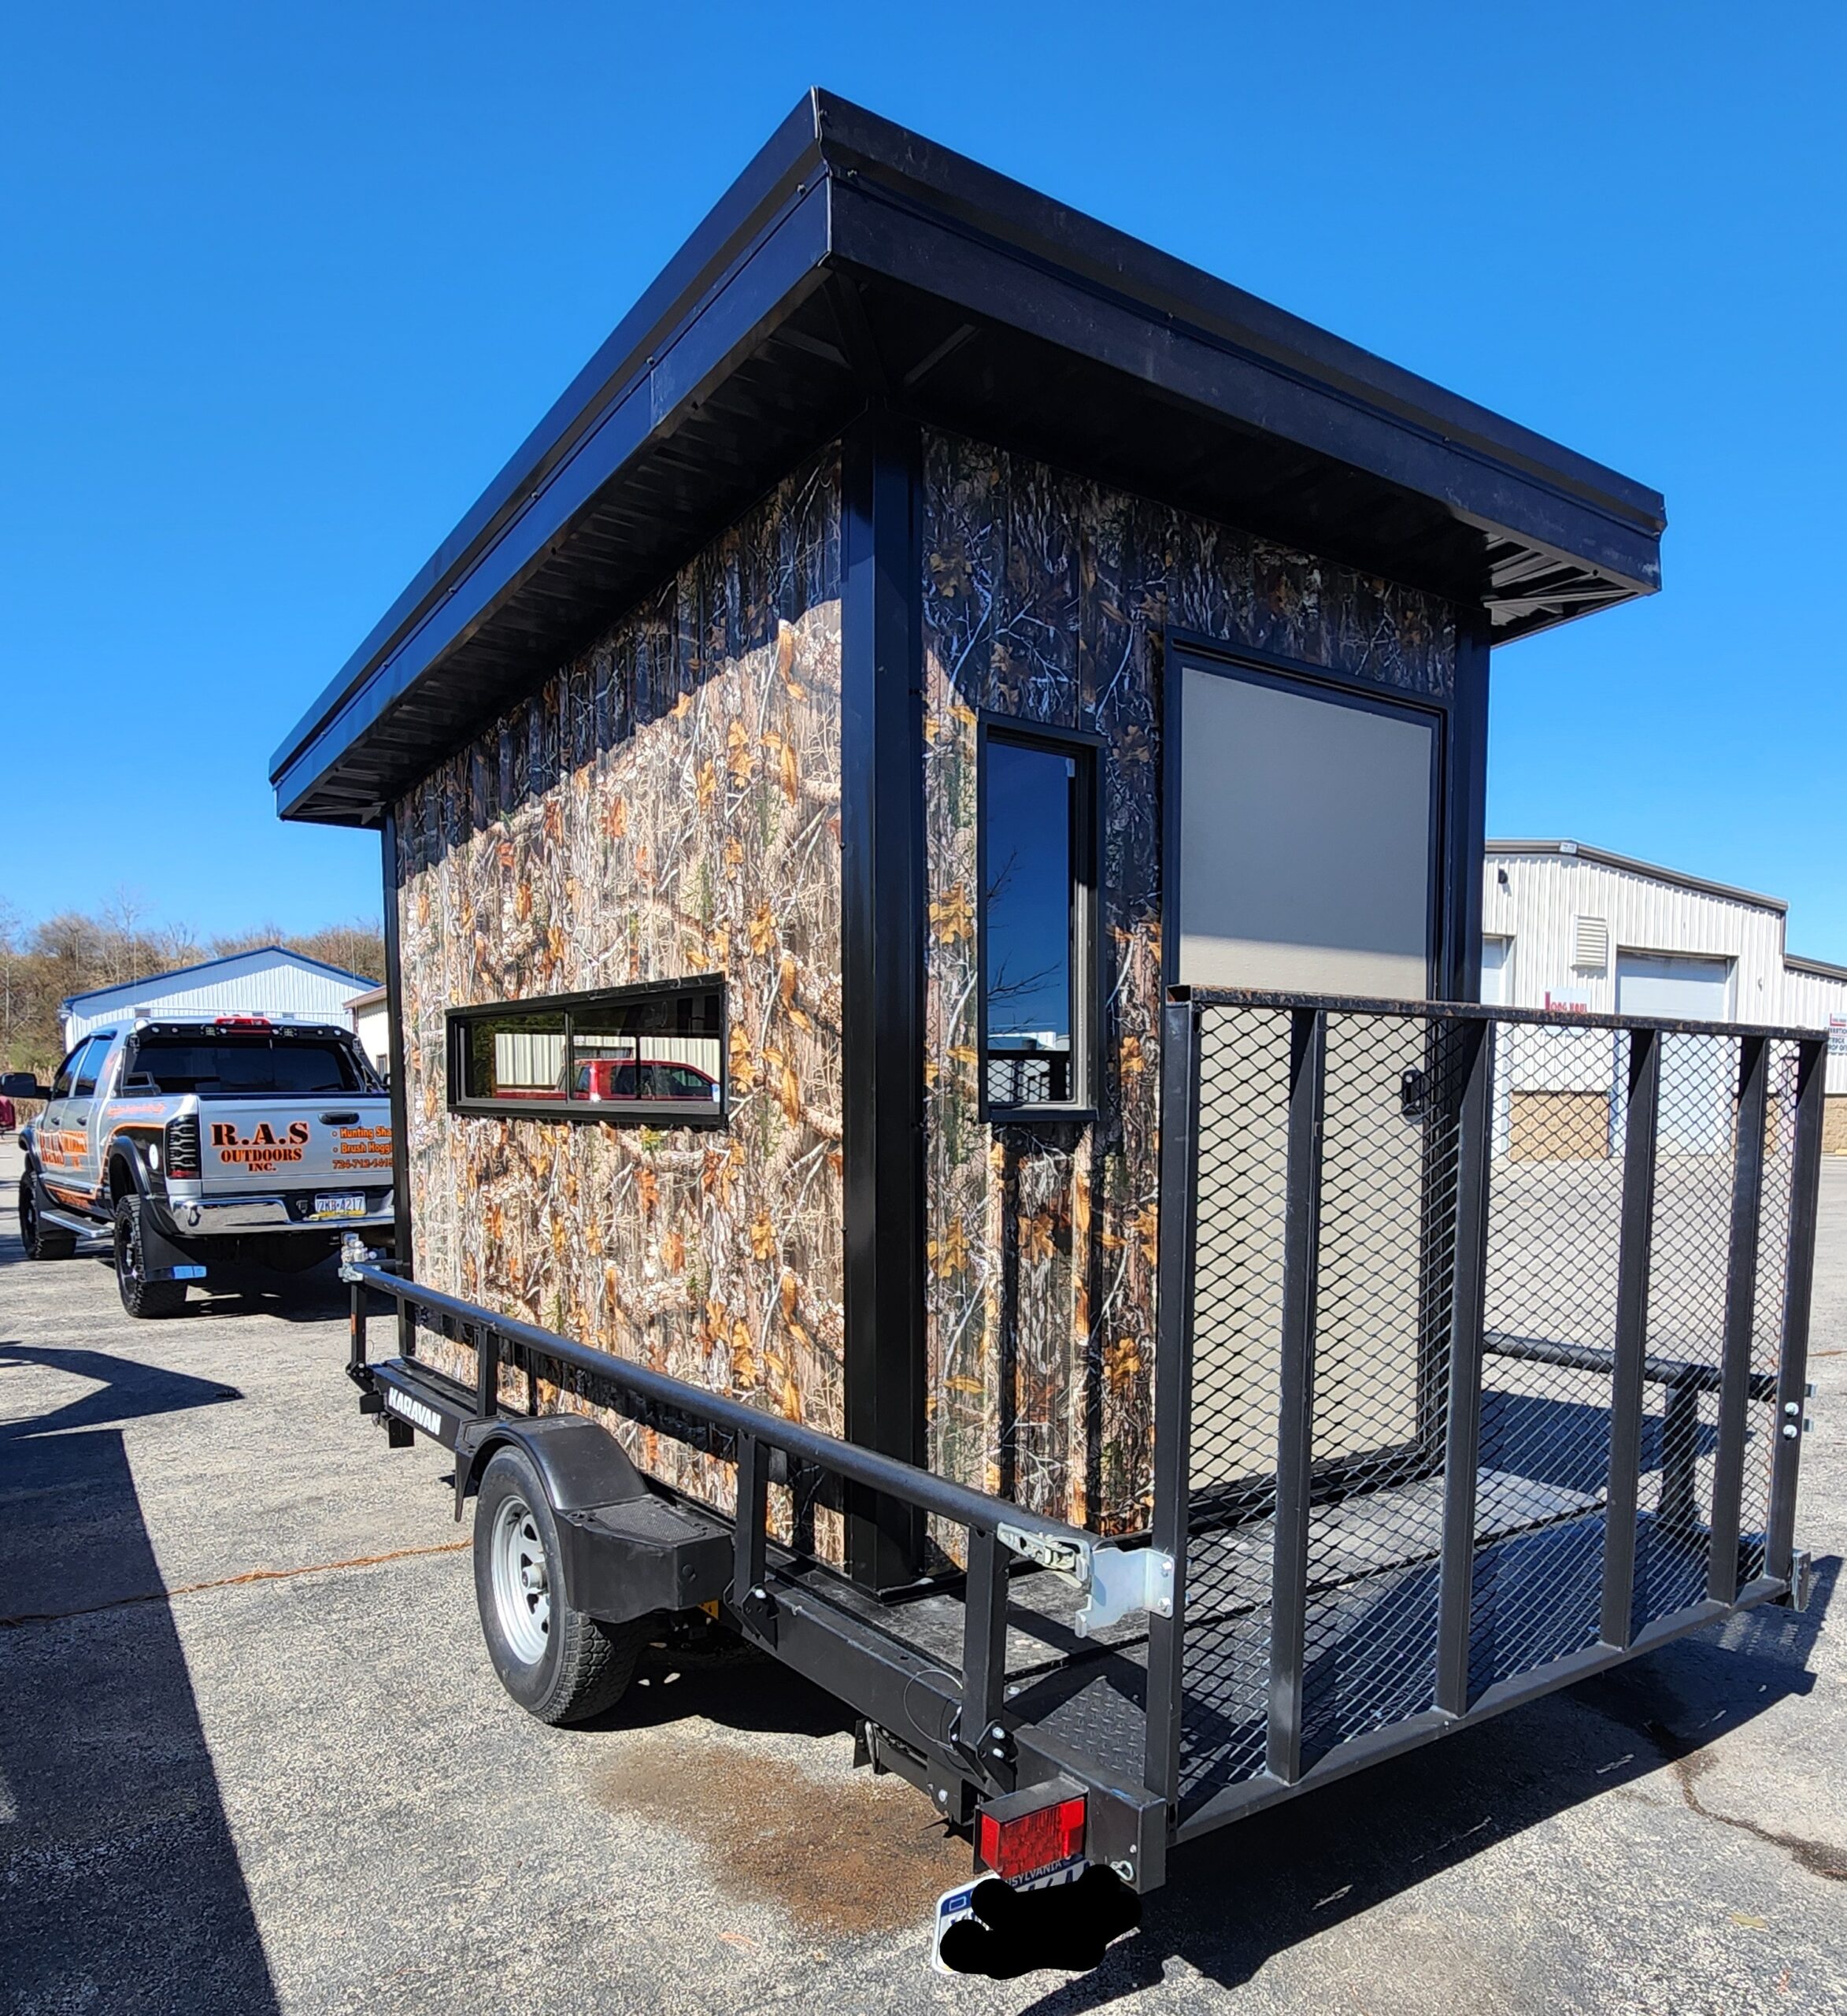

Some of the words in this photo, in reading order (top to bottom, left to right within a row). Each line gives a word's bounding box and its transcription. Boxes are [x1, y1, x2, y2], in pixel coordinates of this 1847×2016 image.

[210, 1121, 309, 1147] R.A.S
[339, 1126, 374, 1140] Hunting
[375, 1125, 392, 1138] Sha
[220, 1147, 302, 1162] OUTDOORS
[340, 1142, 367, 1154] Brush
[248, 1162, 277, 1172] INC.
[388, 1387, 442, 1436] KARAVAN
